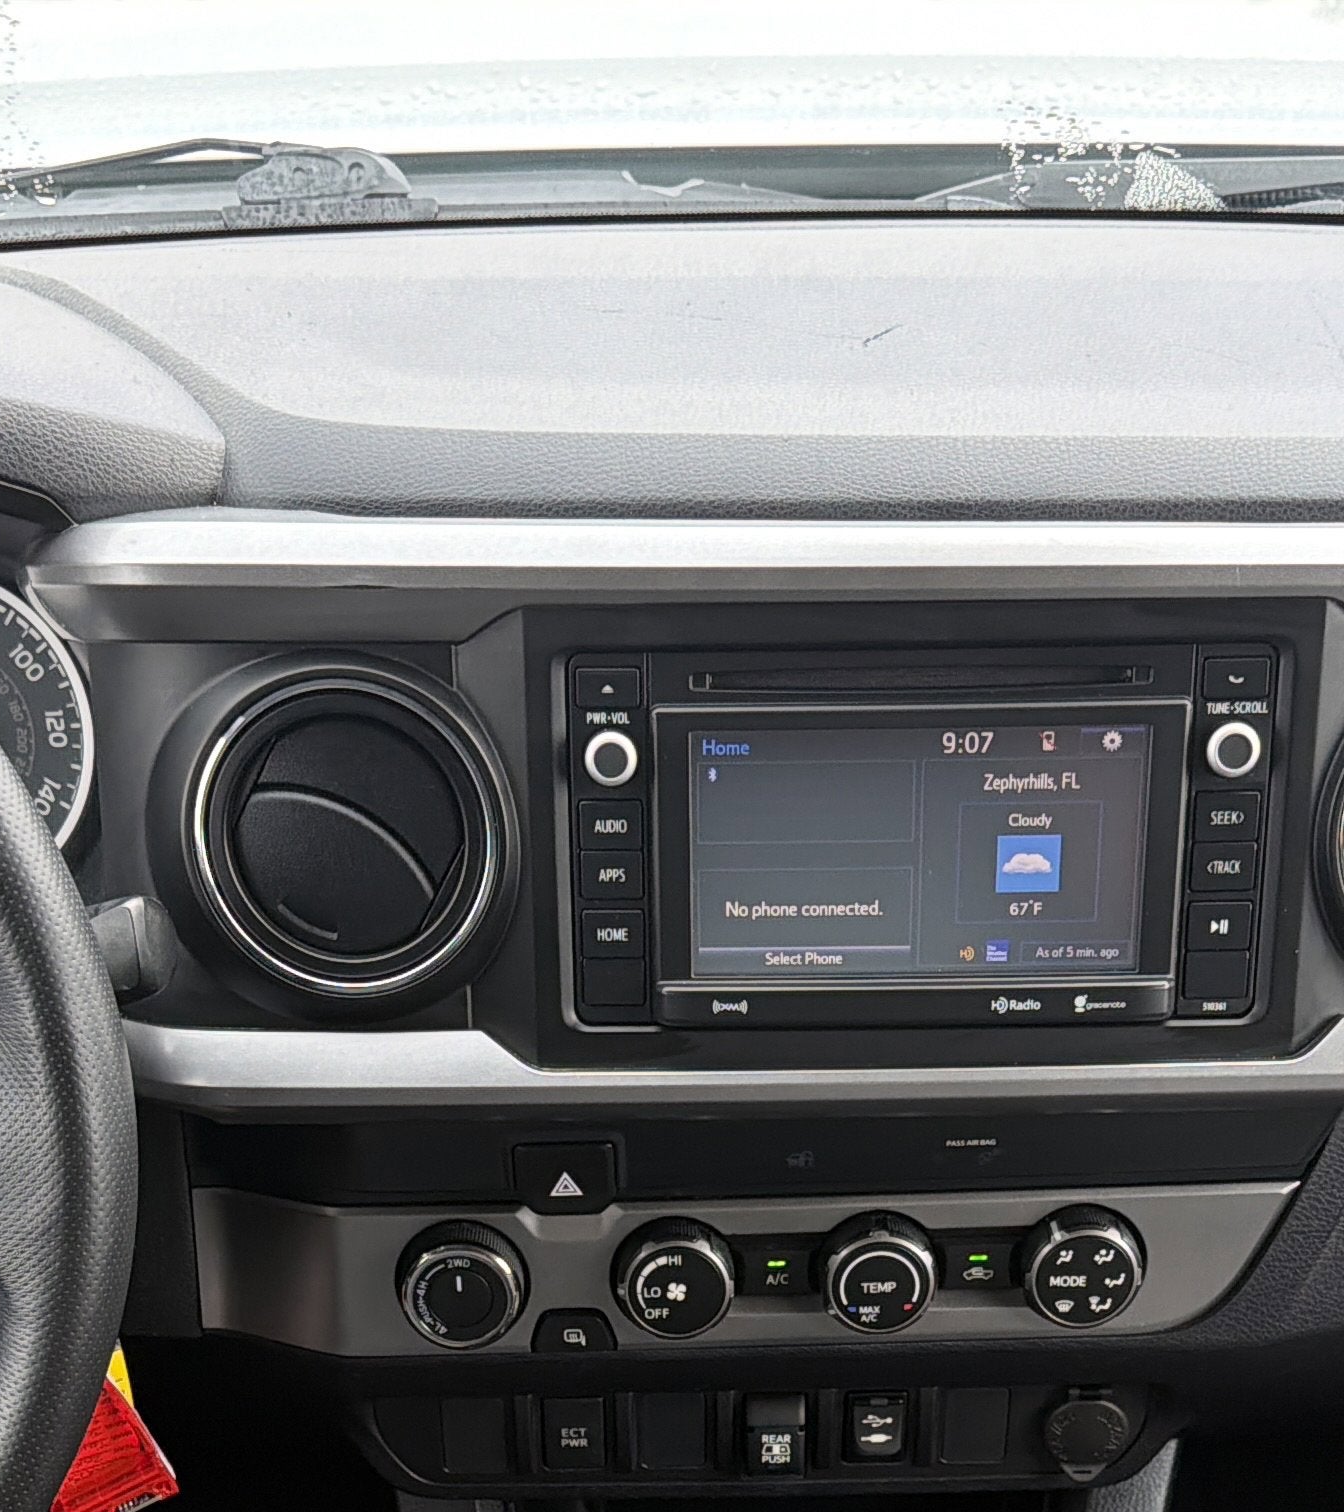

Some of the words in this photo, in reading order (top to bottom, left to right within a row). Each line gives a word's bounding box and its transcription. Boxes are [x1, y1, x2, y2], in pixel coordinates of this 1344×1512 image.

[9, 643, 45, 682] 100
[44, 709, 68, 748] 120
[702, 739, 750, 756] Home
[942, 731, 994, 754] 9:07
[983, 773, 1057, 793] Zephyrhills,
[1061, 772, 1080, 790] FL
[594, 819, 627, 834] AUDIO
[1008, 813, 1053, 830] Cloudy
[598, 869, 626, 882] APPS
[725, 901, 748, 917] No
[751, 901, 798, 920] phone
[801, 899, 884, 917] connected.
[596, 928, 629, 942] HOME
[765, 952, 802, 966] Select
[805, 951, 843, 965] Phone
[1036, 947, 1049, 958] As
[1052, 946, 1063, 958] of
[1076, 947, 1098, 958] min.
[1100, 948, 1119, 959] ago
[1009, 998, 1041, 1011] Radio
[446, 1258, 470, 1268] 2WD
[668, 1255, 682, 1266] HI
[766, 1273, 789, 1286] A/C
[1049, 1275, 1087, 1288] MODE
[643, 1287, 662, 1298] LO
[861, 1281, 897, 1294] TEMP
[644, 1308, 670, 1320] OFF
[859, 1306, 881, 1314] MAX
[860, 1314, 878, 1323] A/C
[561, 1428, 586, 1438] ECT
[761, 1434, 791, 1444] REAR
[561, 1438, 588, 1448] PWR
[761, 1453, 791, 1464] PUSH
